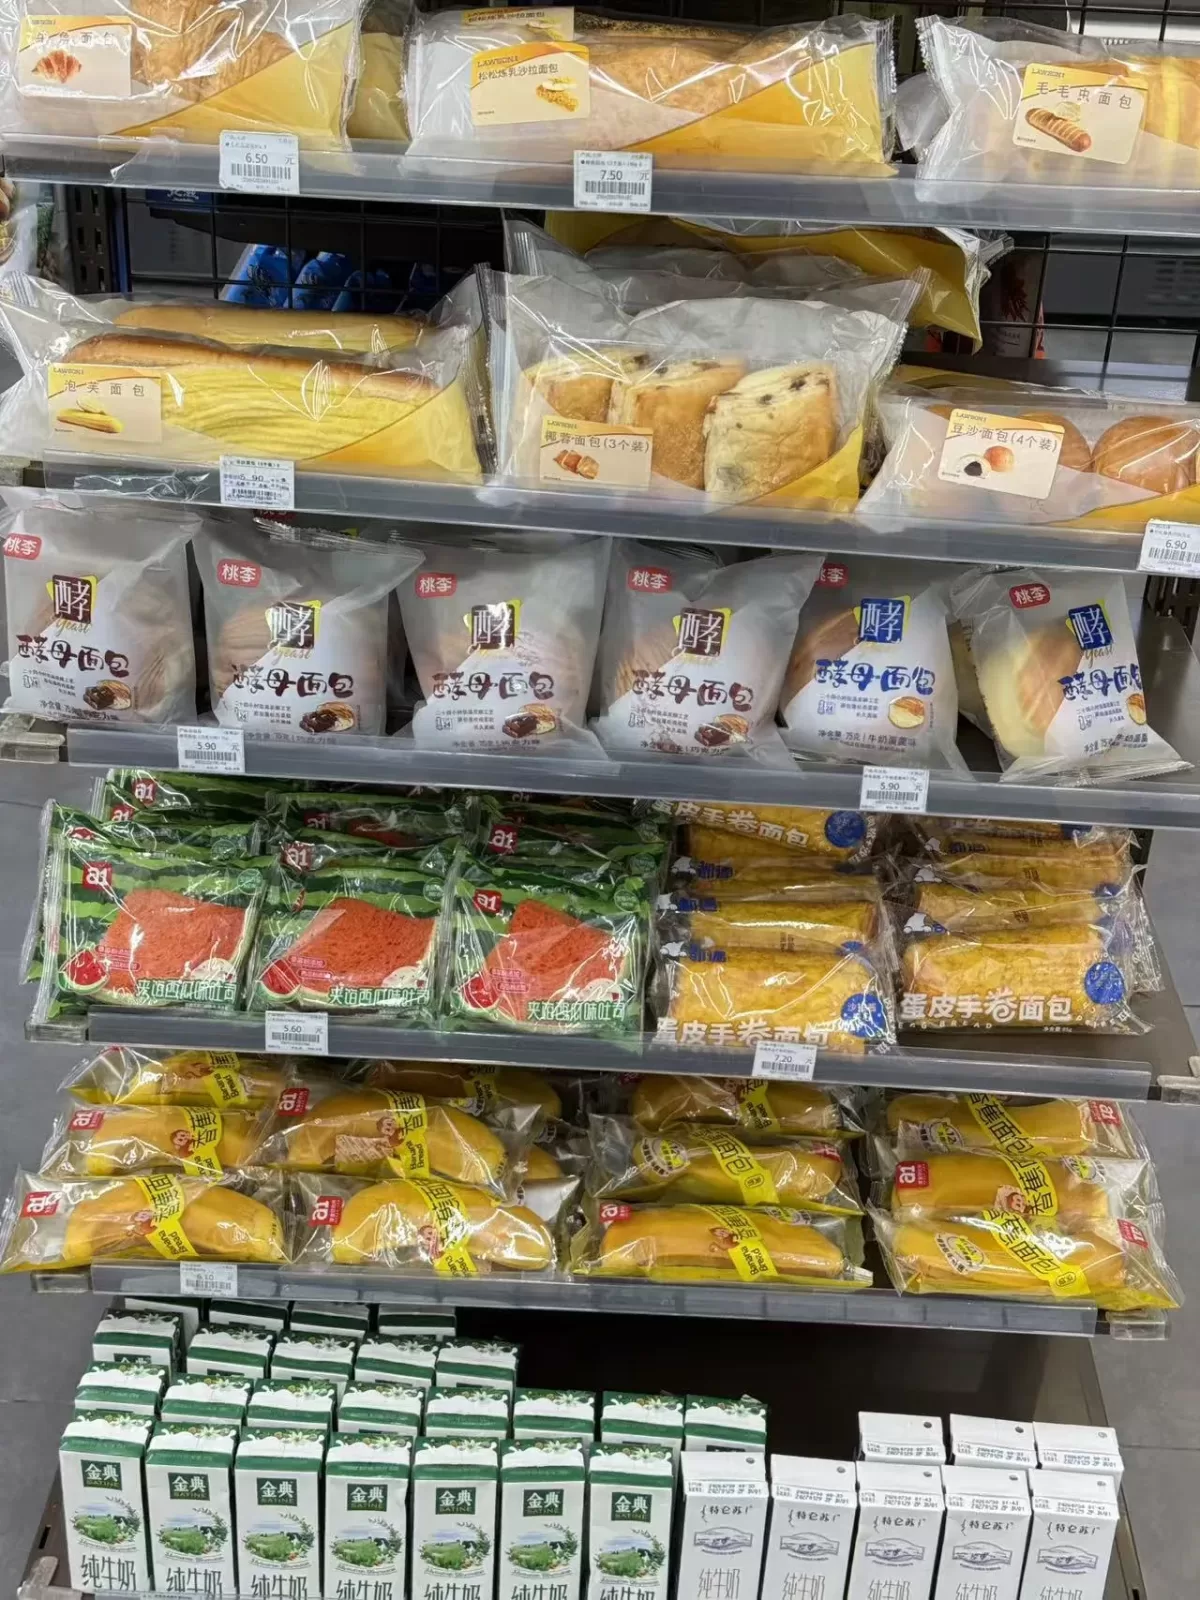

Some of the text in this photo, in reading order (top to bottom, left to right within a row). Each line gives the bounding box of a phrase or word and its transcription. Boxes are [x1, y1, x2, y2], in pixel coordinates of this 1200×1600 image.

[478, 63, 559, 80] 松松炼乳沙拉面包
[1036, 82, 1133, 110] 毛毛虫面包
[245, 152, 269, 165] 6.50
[600, 169, 624, 182] 7.50
[65, 379, 145, 398] 泡芙面包
[952, 421, 1059, 453] 豆沙面包(4个装)
[4, 537, 39, 557] 桃李
[1165, 539, 1188, 550] 6.90
[221, 563, 257, 584] 桃李
[632, 570, 668, 590] 桃李
[419, 576, 453, 594] 桃李
[54, 579, 92, 621] 酵
[1013, 586, 1048, 606] 桃李
[861, 601, 905, 642] 酵
[1070, 607, 1111, 649] 酵
[679, 612, 724, 654] 酵
[16, 634, 130, 678] 酵母面包
[230, 663, 355, 700] 酵母面包
[431, 671, 555, 701] 酵母面包
[814, 657, 946, 696] 酵母面包
[632, 668, 754, 712] 酵母面包
[196, 741, 217, 751] 5.90
[879, 781, 900, 791] 5.90
[899, 987, 1073, 1023] 蛋皮手卷面包
[283, 1024, 302, 1033] 5.60
[655, 1015, 830, 1046] 蛋皮手卷面包
[774, 1054, 793, 1063] 7.20
[84, 1463, 120, 1483] 金典
[171, 1475, 207, 1494] 金典
[260, 1480, 294, 1499] 金典
[350, 1486, 385, 1504] 金典
[438, 1490, 473, 1507] 金典
[526, 1491, 561, 1510] 金典
[614, 1495, 648, 1513] 金典
[81, 1553, 137, 1591] 纯牛奶
[165, 1566, 223, 1596] 纯牛奶
[251, 1574, 308, 1600] 纯牛奶
[697, 1567, 741, 1600] 纯牛奶
